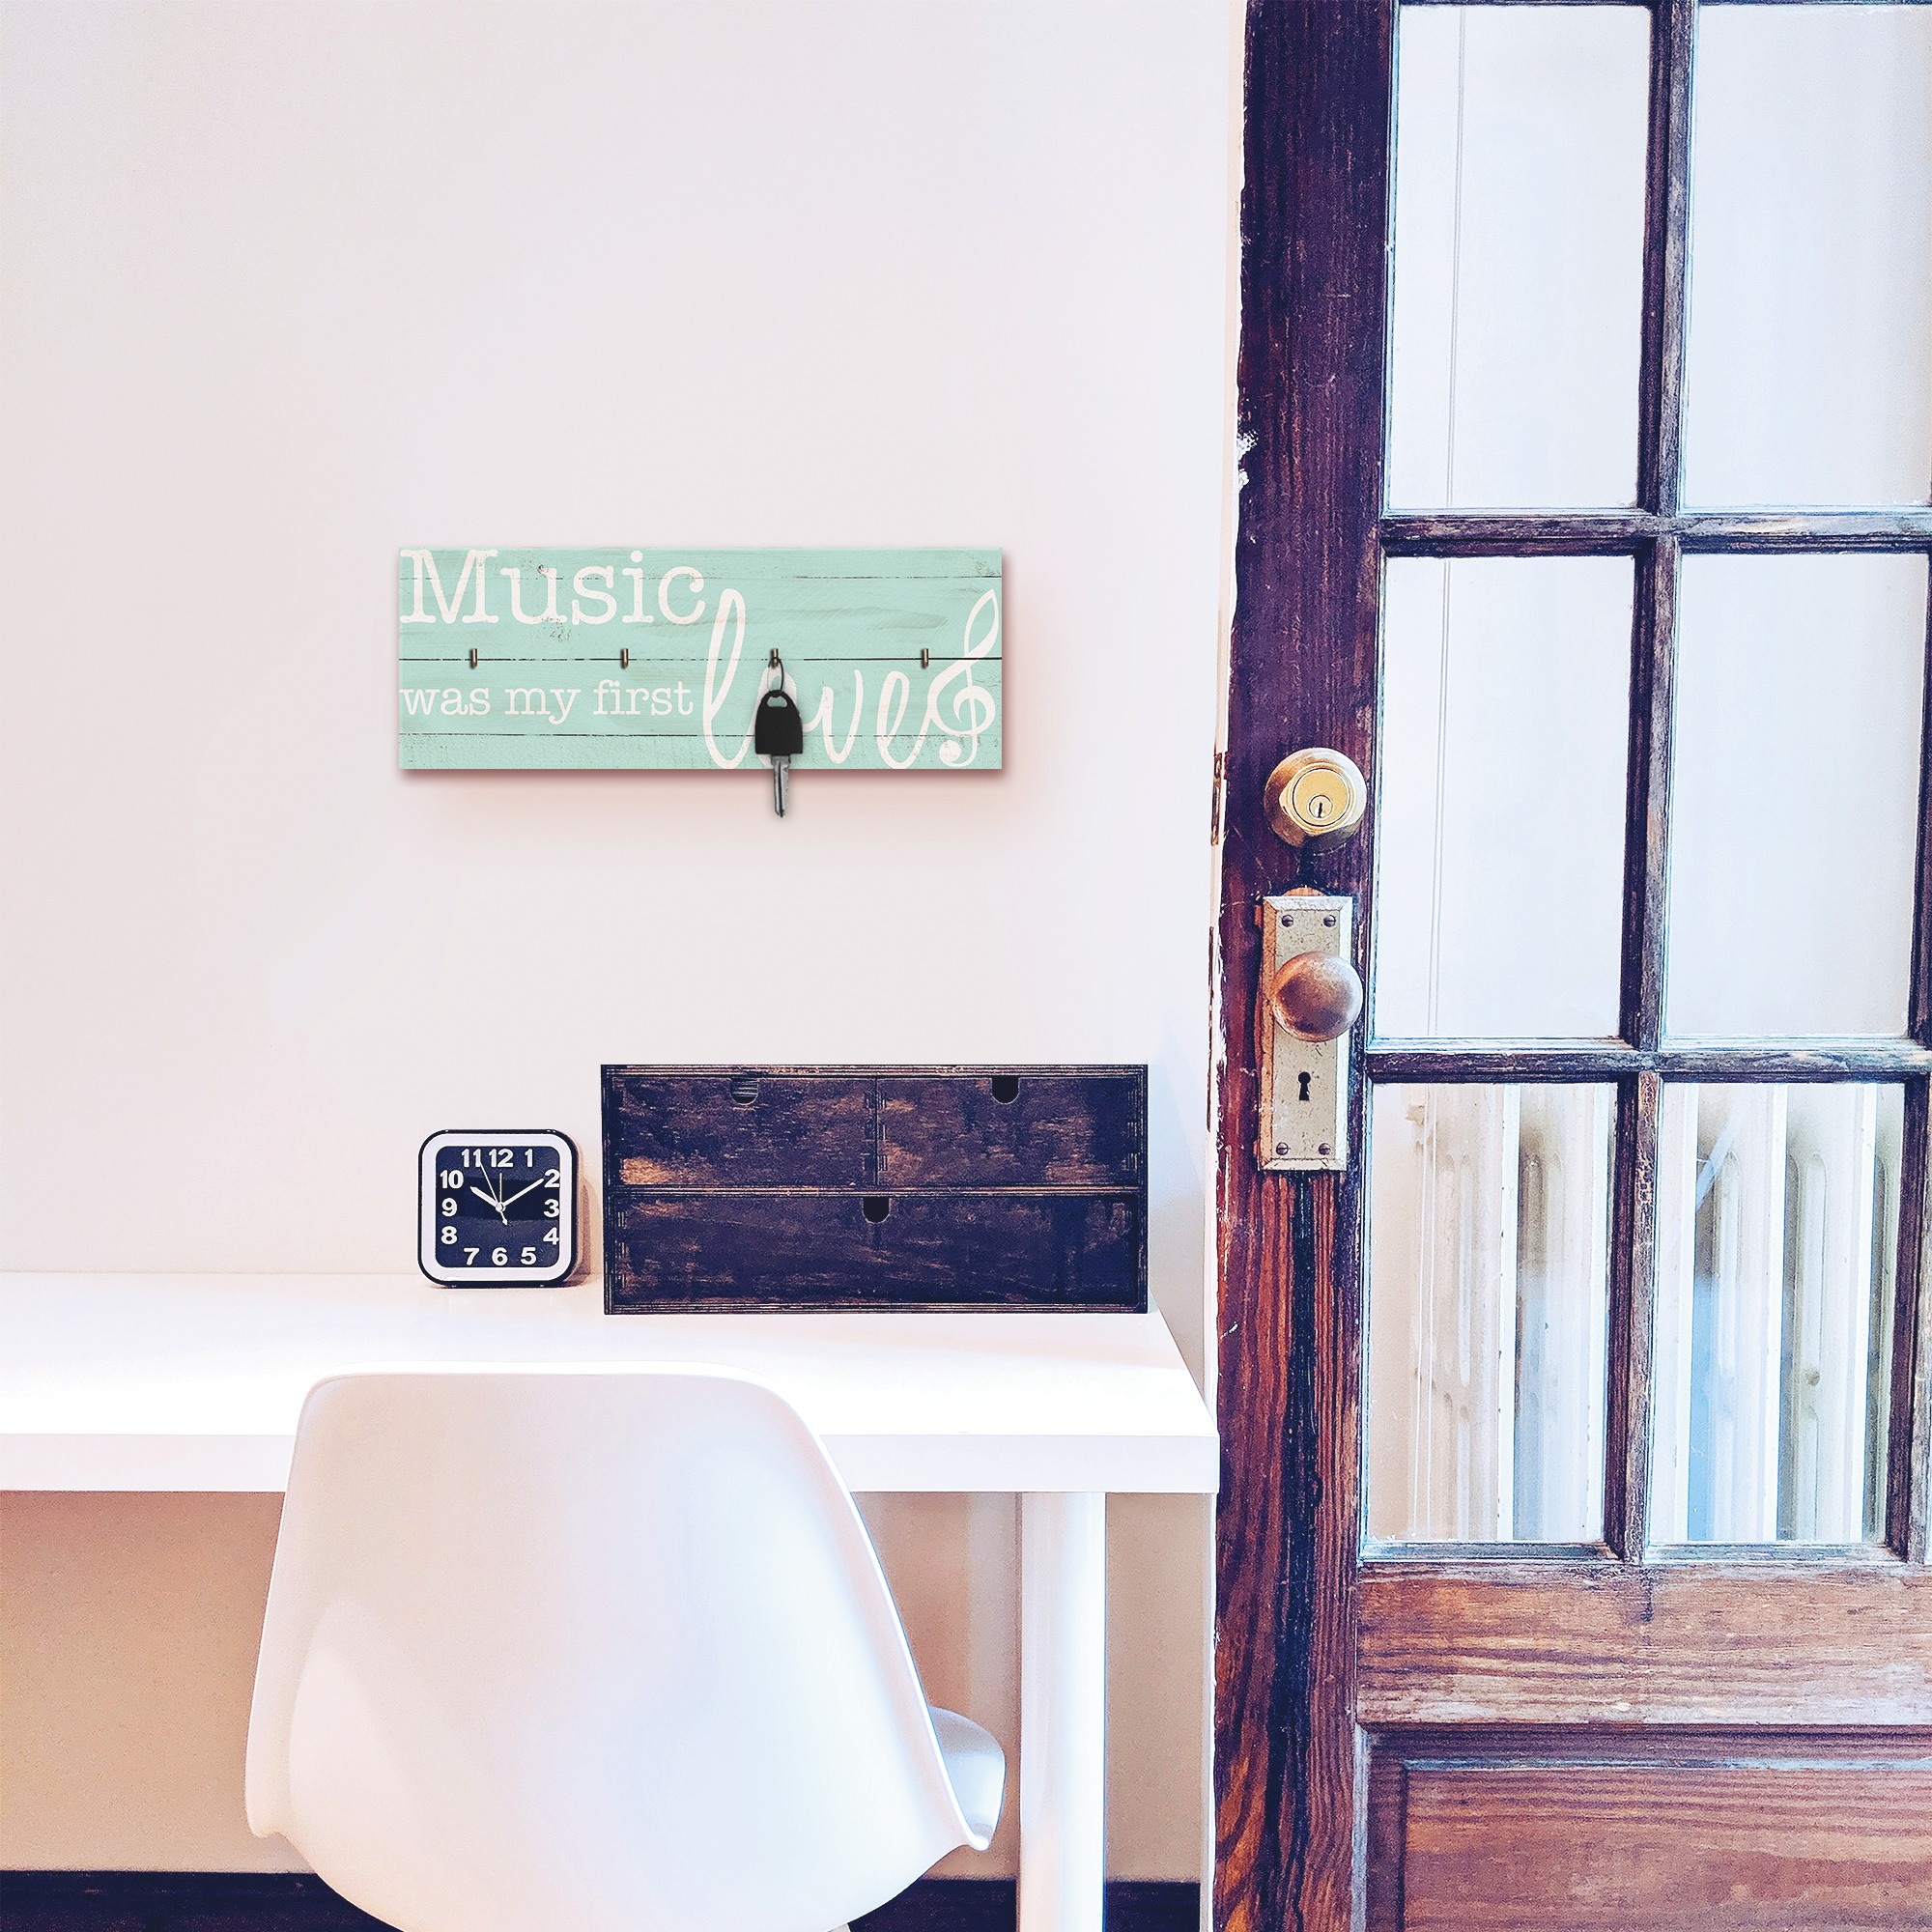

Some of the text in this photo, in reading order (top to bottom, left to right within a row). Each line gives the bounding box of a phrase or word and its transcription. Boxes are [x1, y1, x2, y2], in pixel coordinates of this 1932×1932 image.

[400, 549, 705, 625] Music
[399, 687, 491, 715] was
[504, 687, 582, 725] my
[593, 679, 694, 715] first
[462, 1149, 481, 1167] 11
[489, 1149, 513, 1167] 12
[525, 1149, 533, 1167] 1
[440, 1170, 464, 1188] 10
[544, 1169, 560, 1187] 2
[441, 1198, 457, 1216] 9
[544, 1199, 559, 1217] 3
[441, 1226, 457, 1244] 8
[543, 1228, 559, 1245] 4
[464, 1248, 479, 1265] 7
[492, 1248, 507, 1265] 6
[521, 1247, 536, 1264] 5
